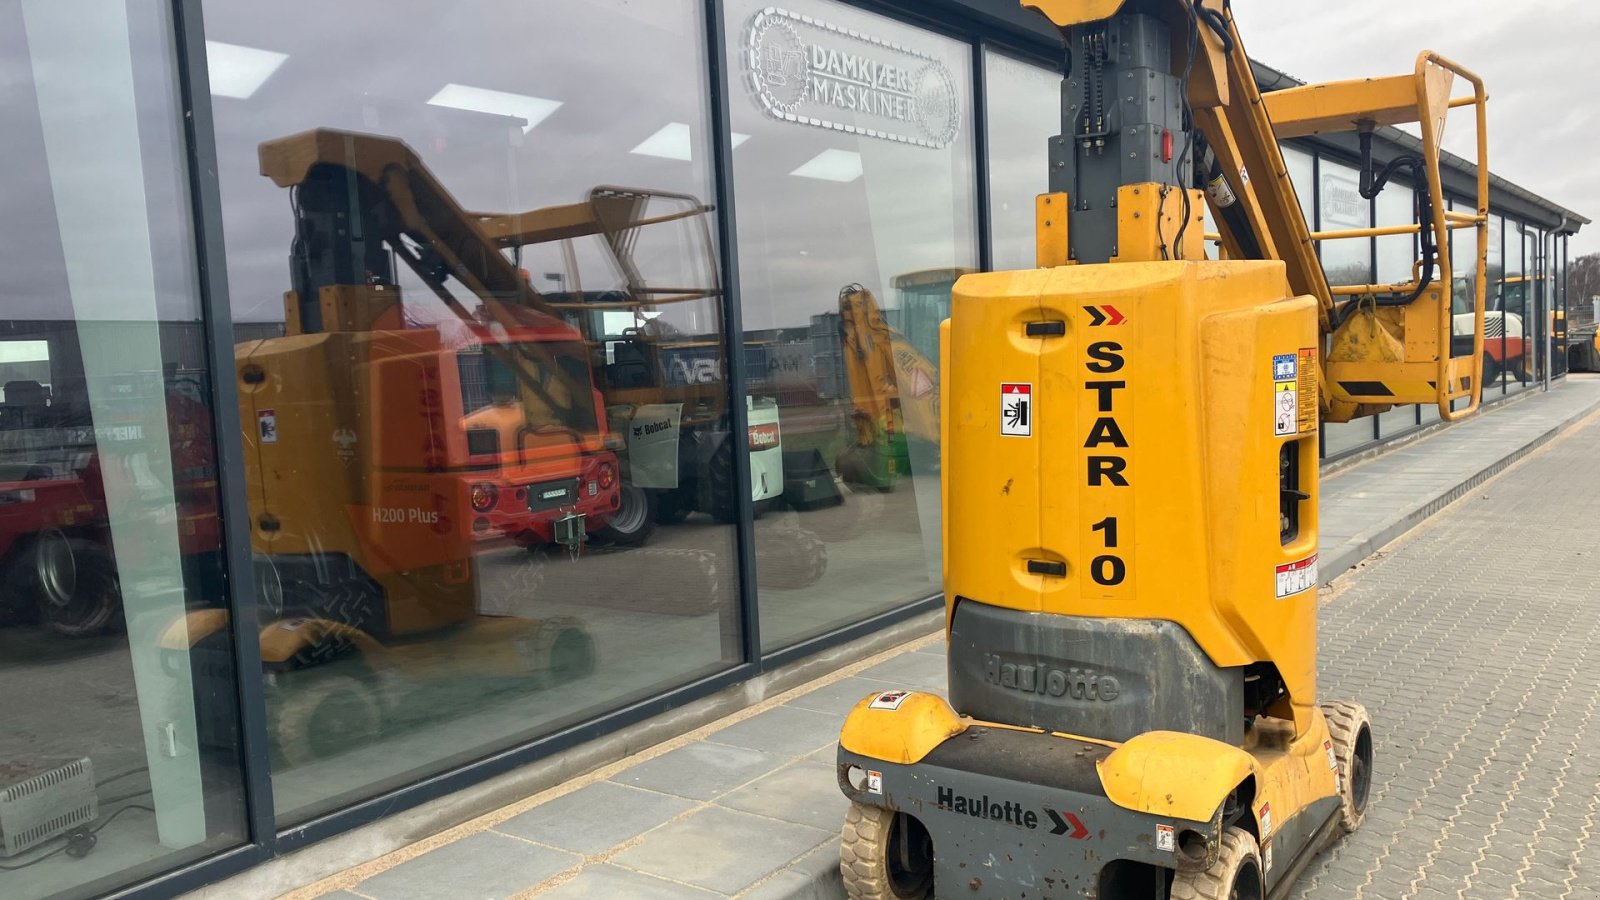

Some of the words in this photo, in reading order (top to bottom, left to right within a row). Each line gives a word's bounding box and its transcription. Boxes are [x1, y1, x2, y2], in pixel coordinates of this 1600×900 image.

[812, 76, 918, 122] MASKINER
[644, 418, 672, 436] Bobcat
[1083, 341, 1130, 487] STAR
[753, 430, 776, 445] Bobcat
[372, 507, 405, 523] H200
[408, 507, 439, 524] Plus
[1091, 516, 1126, 586] 10
[984, 652, 1122, 702] Haulotte
[937, 786, 1039, 830] Haulotte
